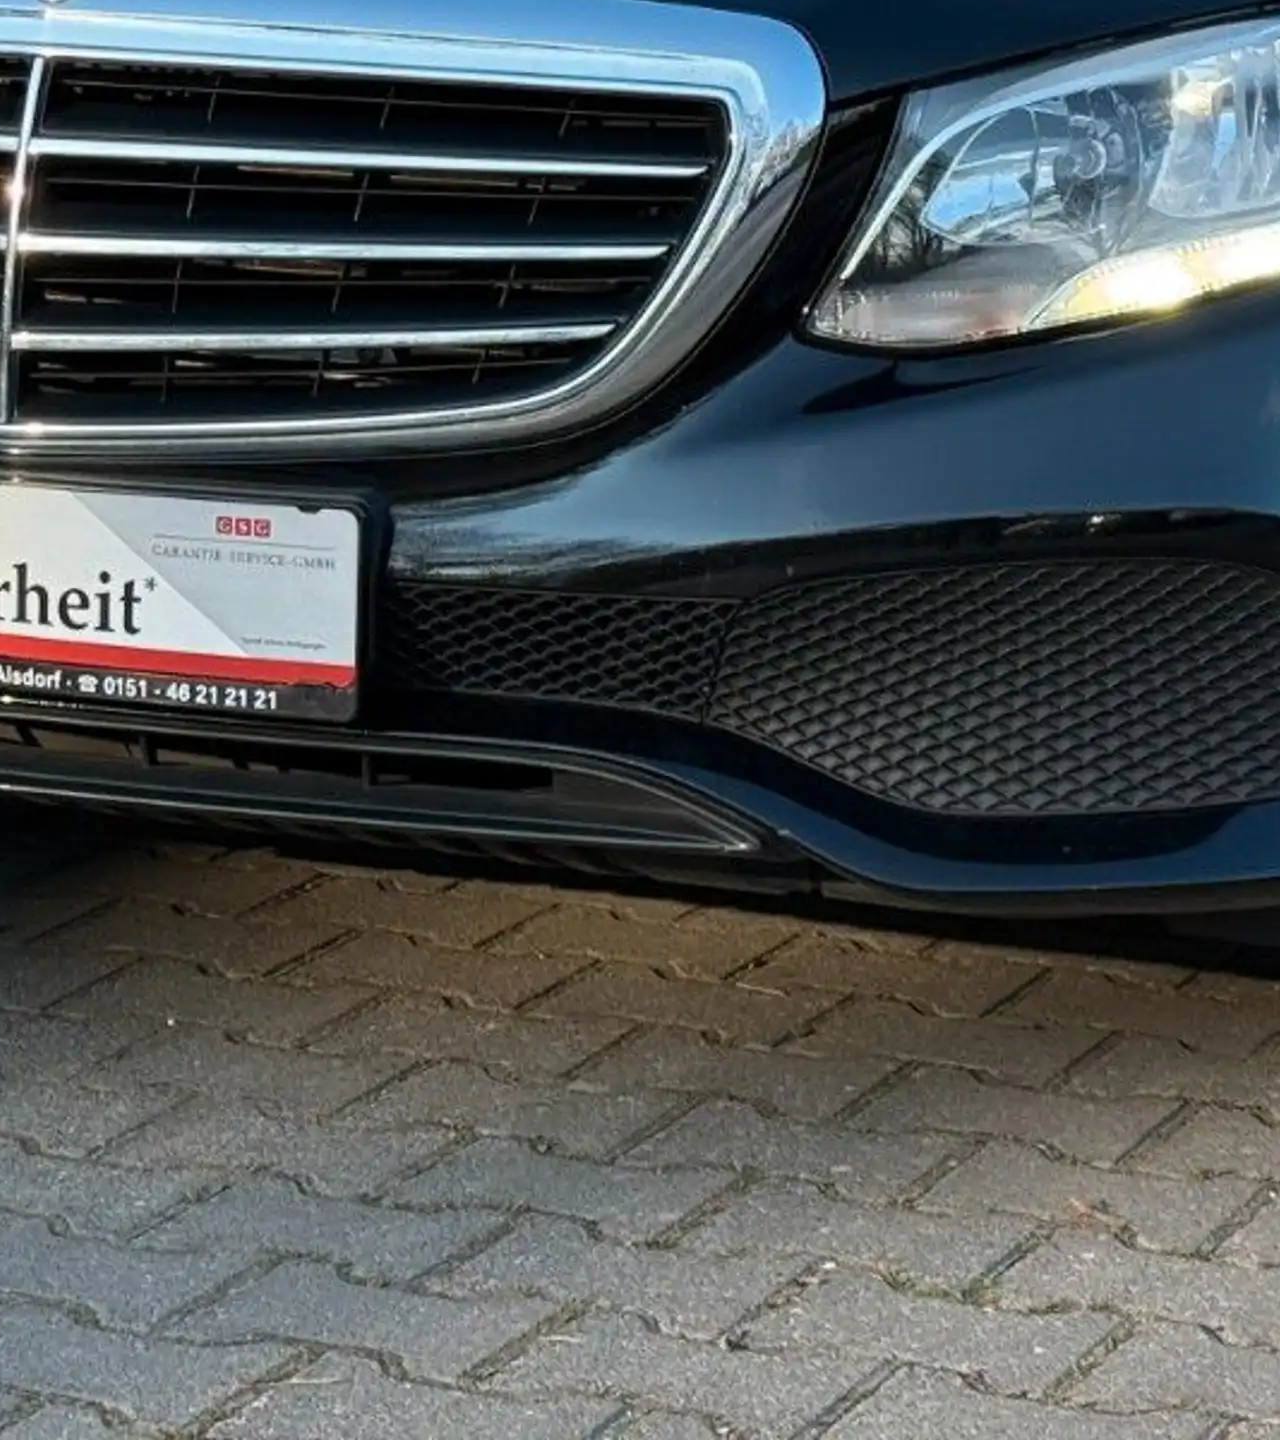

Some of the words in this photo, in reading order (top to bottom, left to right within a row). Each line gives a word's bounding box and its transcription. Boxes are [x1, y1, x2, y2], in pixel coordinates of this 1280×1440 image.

[103, 676, 147, 698] 0151
[195, 684, 218, 704] 21
[224, 687, 247, 707] 21
[253, 690, 277, 710] 21
